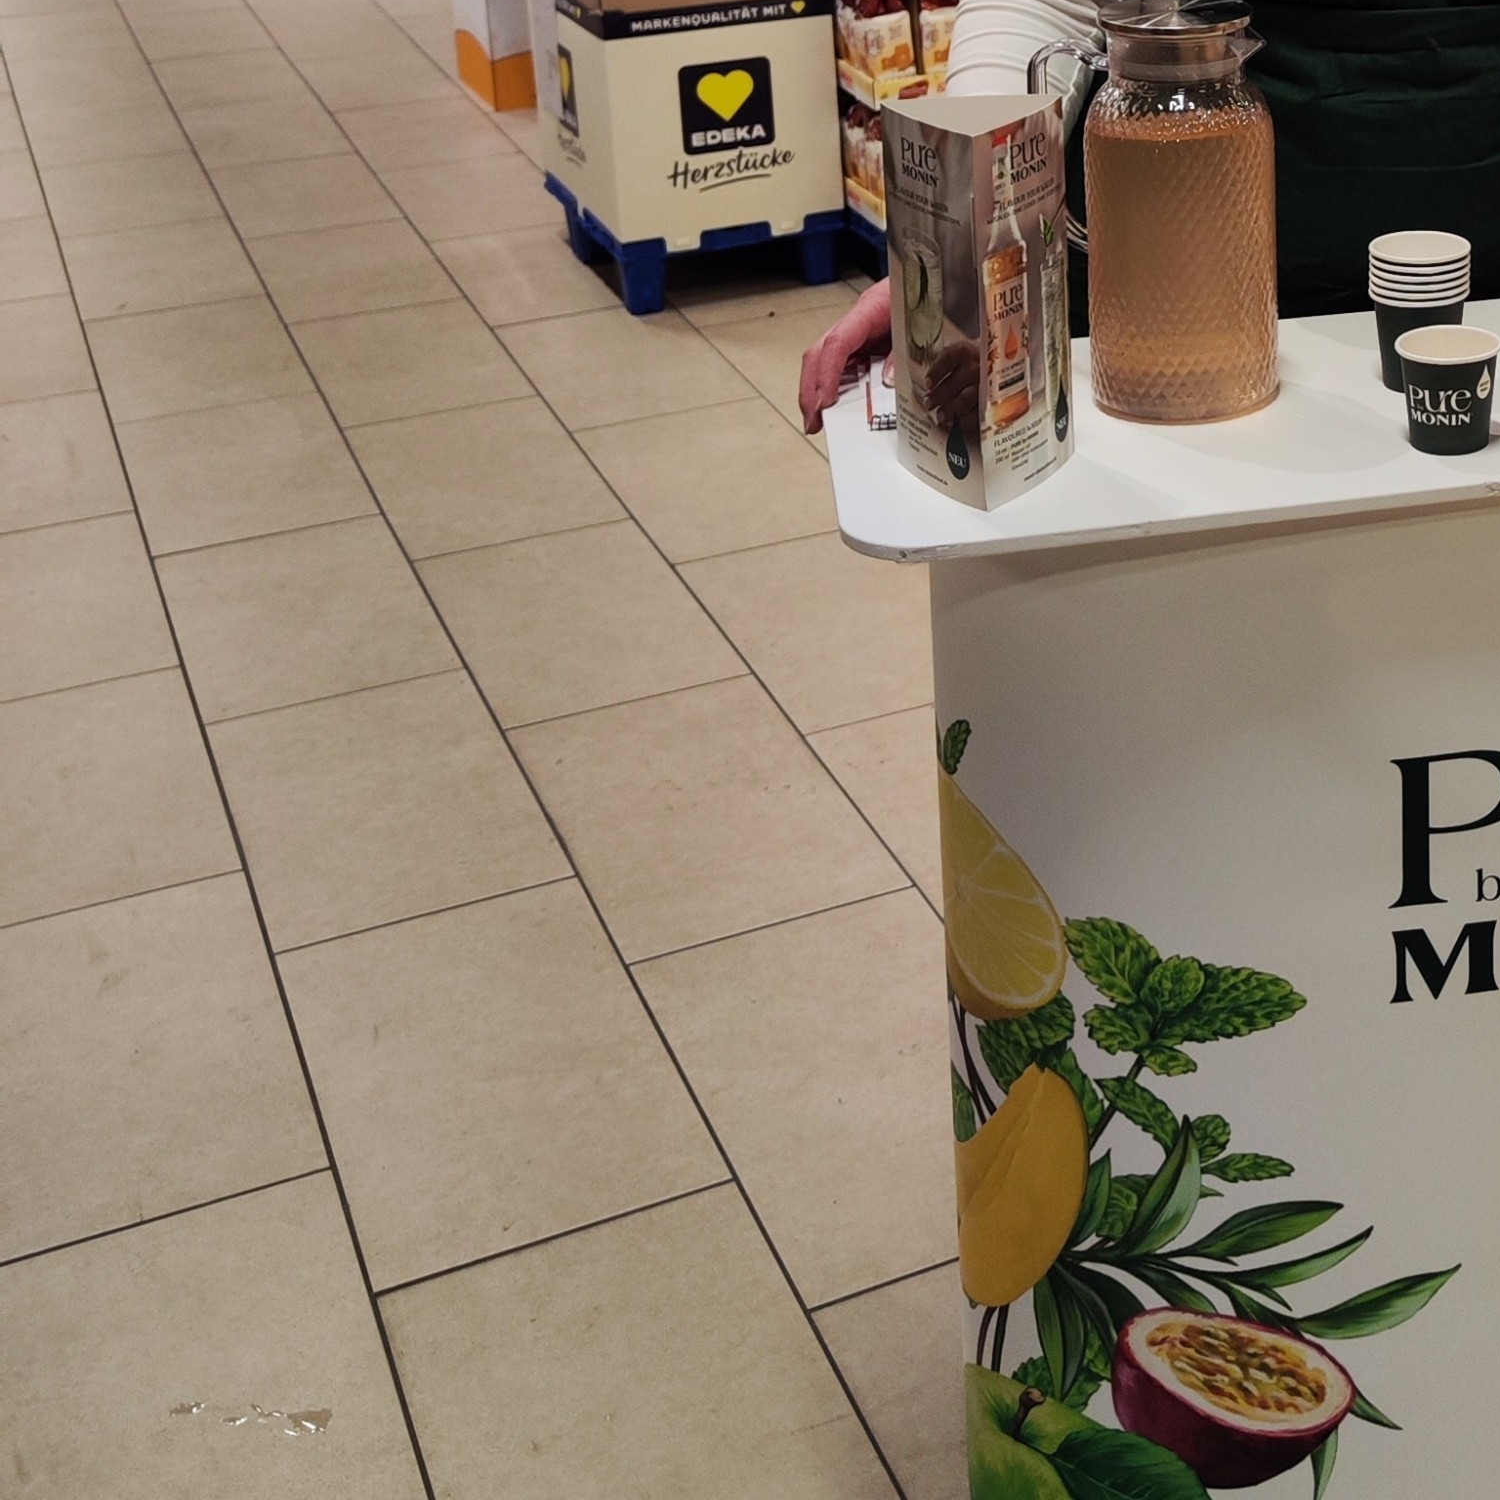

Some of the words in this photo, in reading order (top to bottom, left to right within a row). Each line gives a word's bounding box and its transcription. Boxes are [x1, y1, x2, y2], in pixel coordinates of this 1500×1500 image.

[630, 5, 759, 33] MARKENQUALITÄT
[762, 2, 788, 18] MIT
[691, 123, 767, 148] EDEKA
[1009, 132, 1046, 171] Pure
[666, 147, 796, 190] Herzstücke
[1010, 157, 1048, 185] MONIN
[1408, 383, 1473, 413] Pure
[1410, 408, 1471, 426] MONIN
[948, 451, 968, 469] NEU
